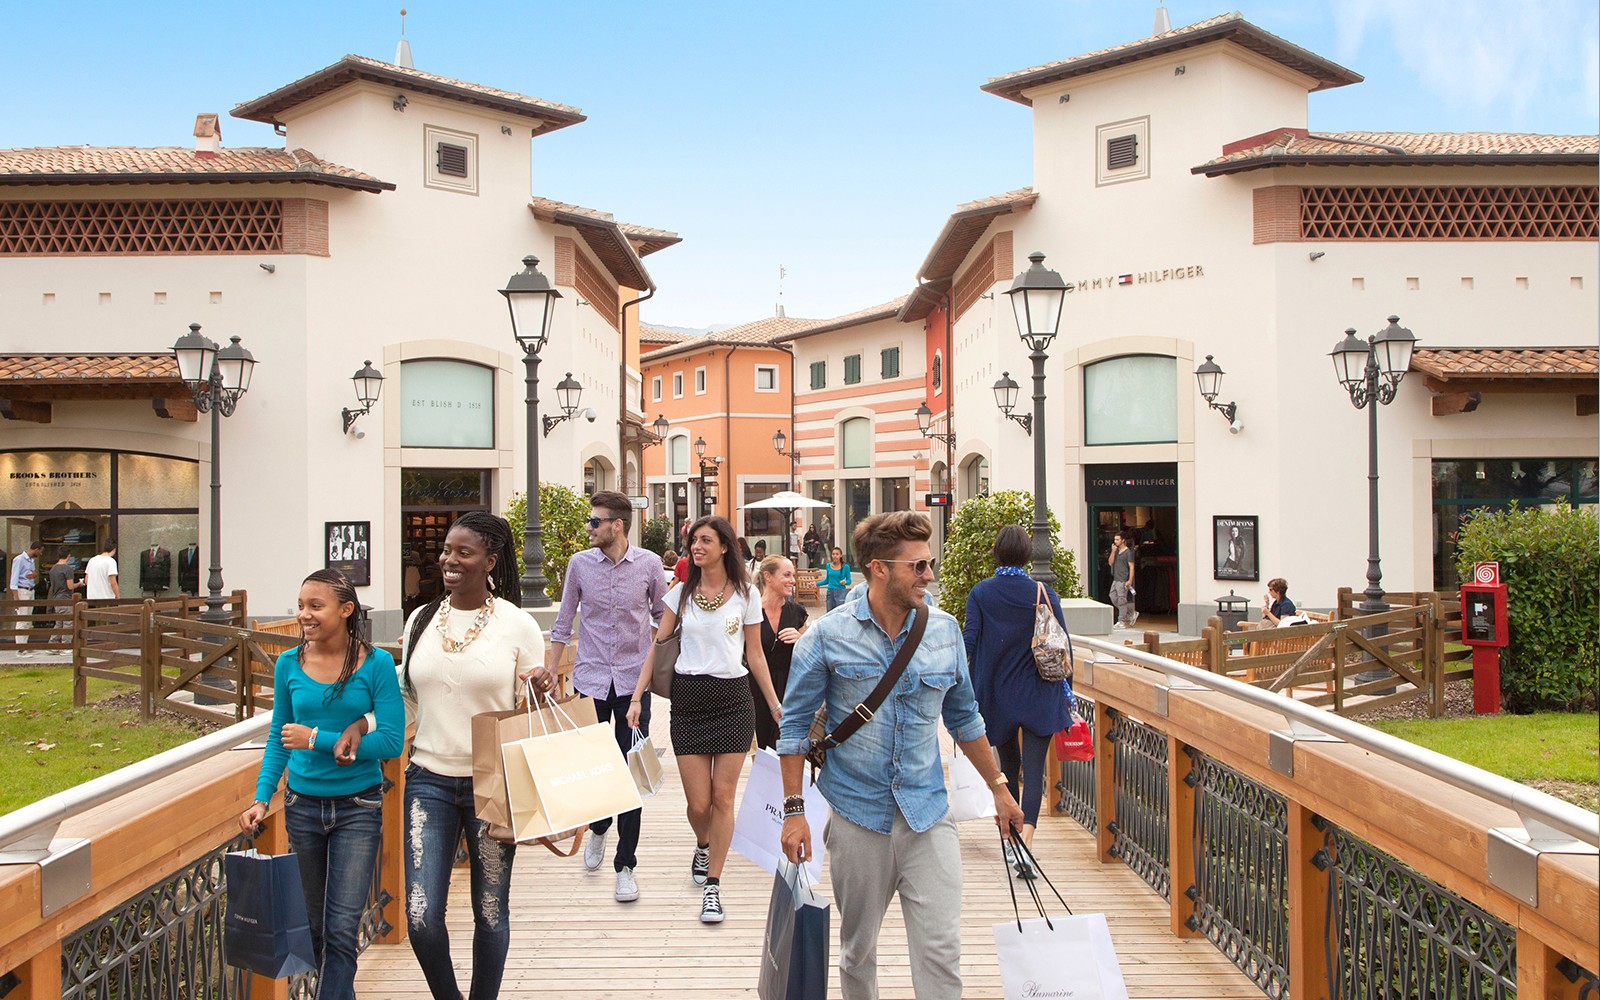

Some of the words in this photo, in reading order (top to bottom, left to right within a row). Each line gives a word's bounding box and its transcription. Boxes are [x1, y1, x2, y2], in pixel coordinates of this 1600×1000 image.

[1066, 276, 1114, 293] OMMY
[1138, 265, 1204, 284] HILFIGER
[1136, 478, 1175, 486] HILFIGER
[549, 770, 588, 786] MICHAEL
[588, 761, 614, 776] KORS
[765, 803, 784, 820] PRA
